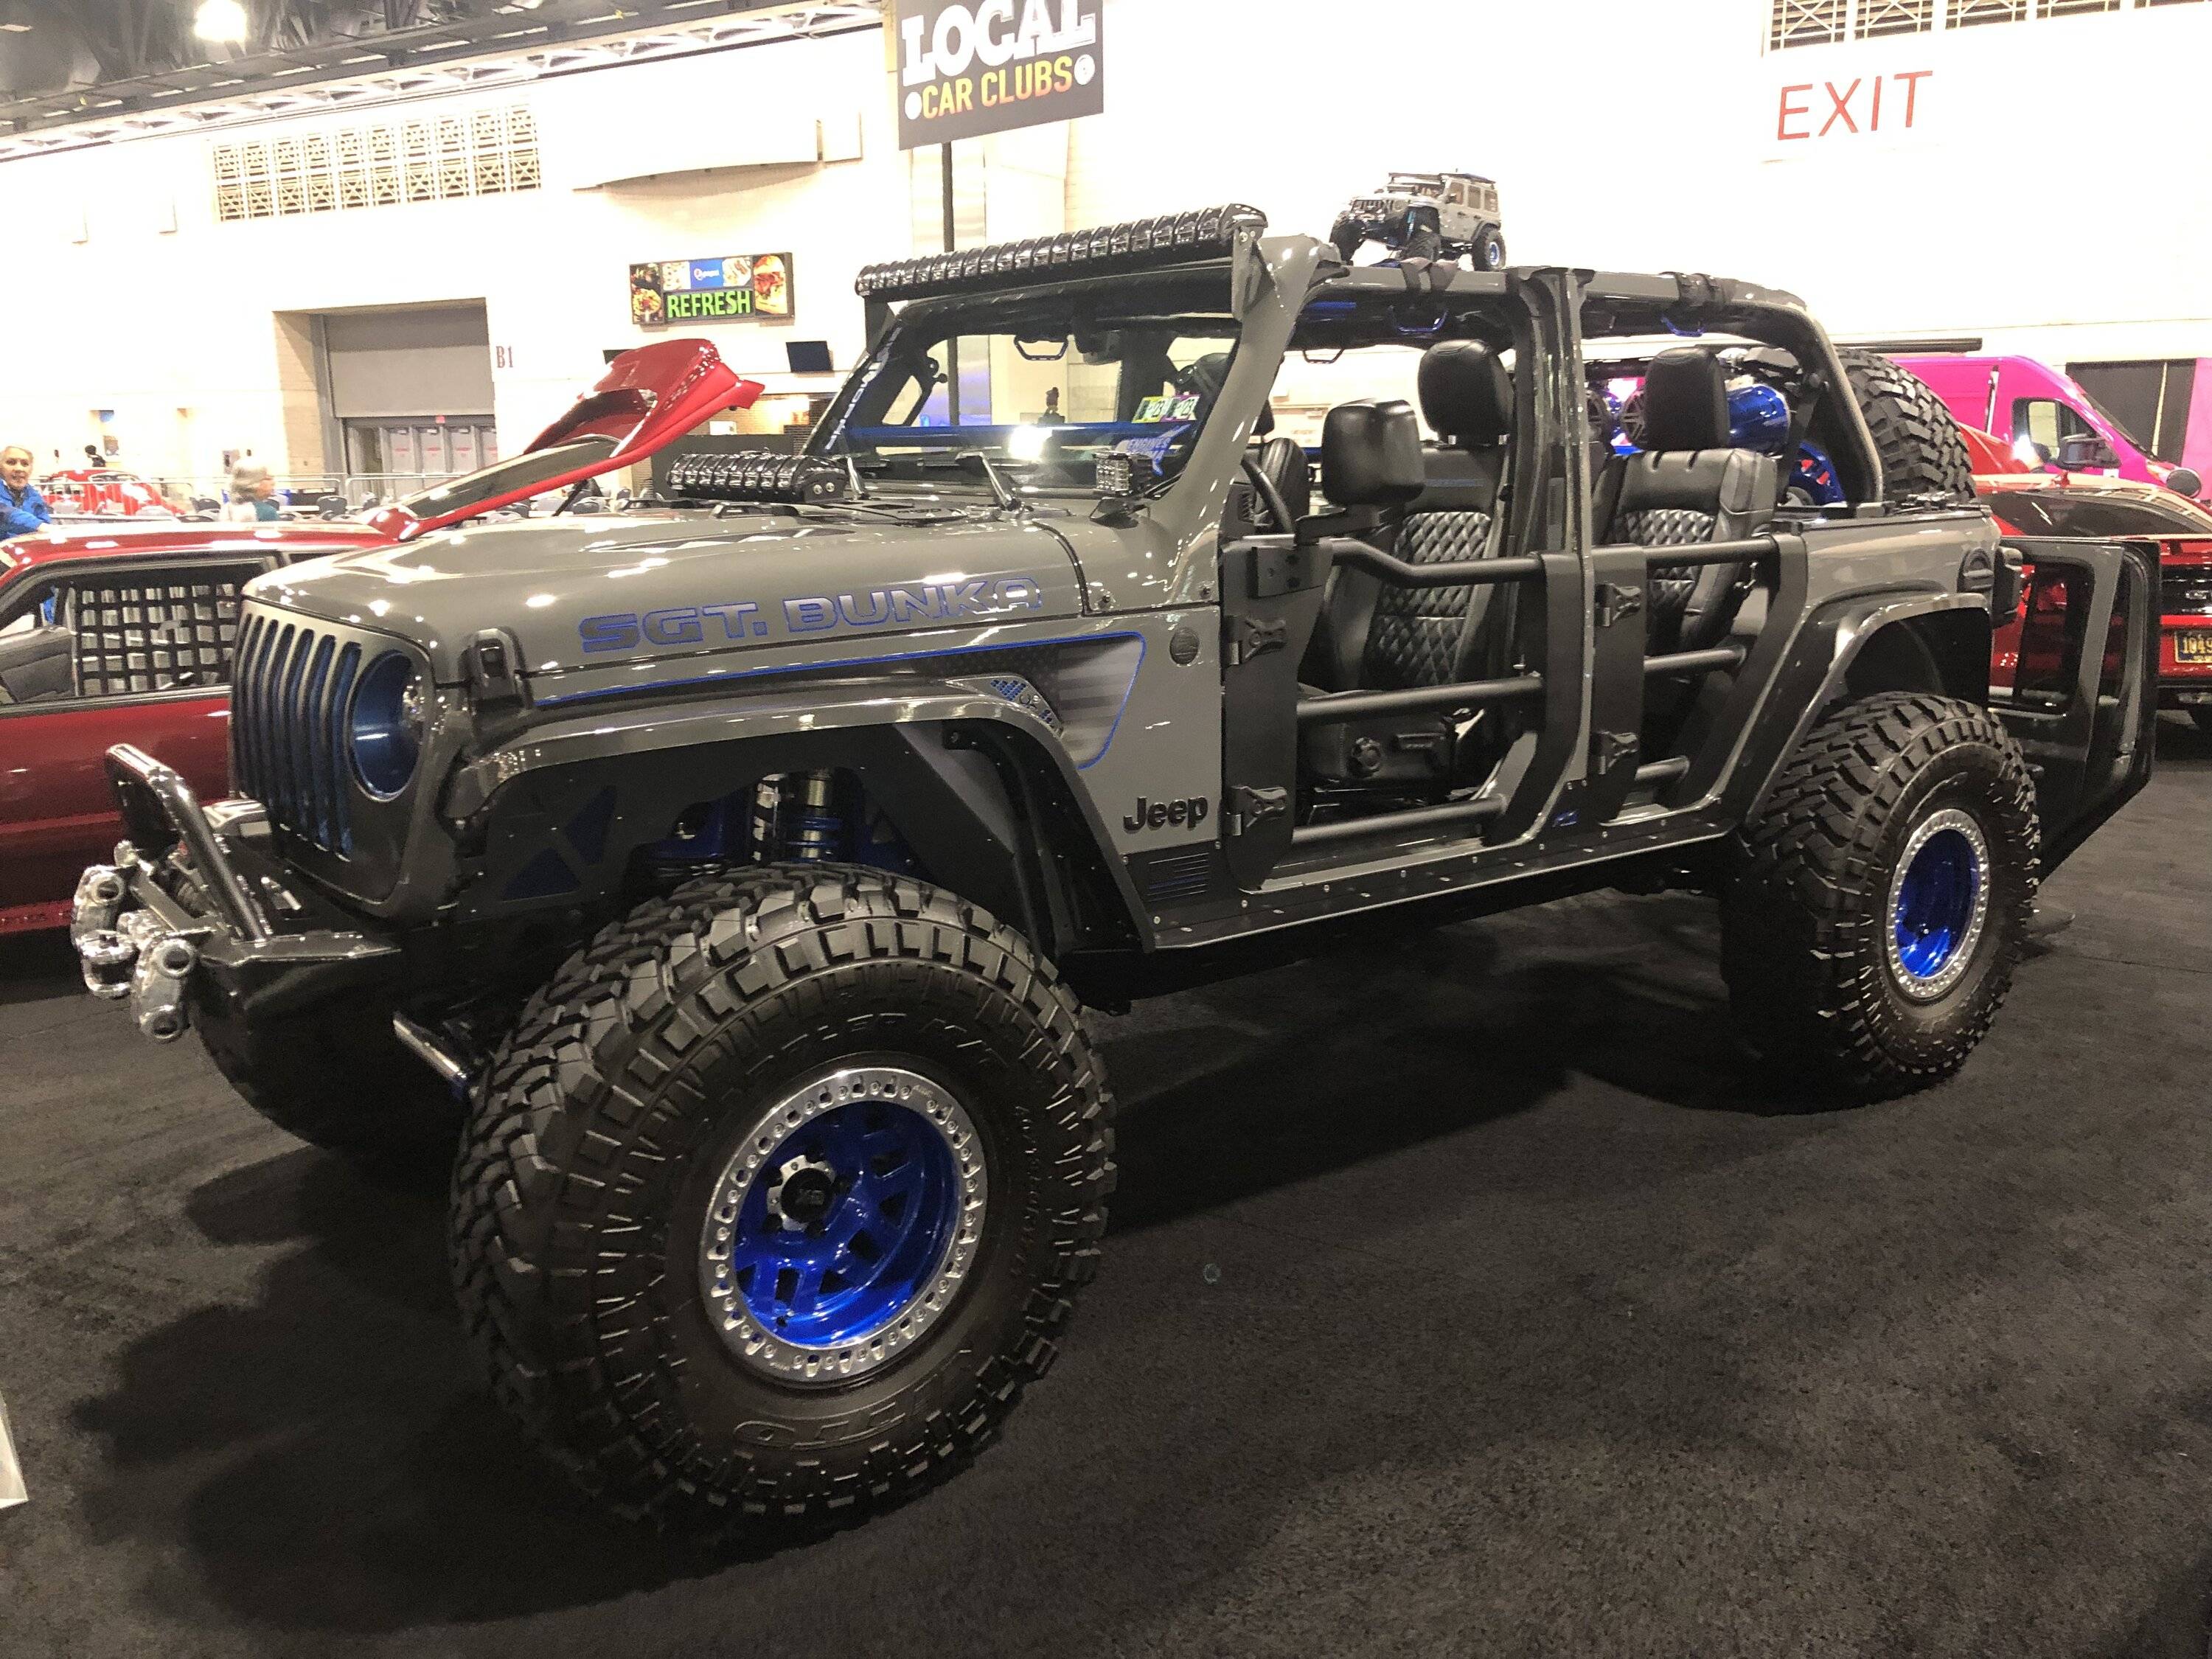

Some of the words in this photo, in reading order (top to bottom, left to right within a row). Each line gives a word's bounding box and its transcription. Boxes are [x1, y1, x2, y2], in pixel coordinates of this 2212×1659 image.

[901, 0, 1096, 86] LOCAL
[922, 77, 974, 119] CAR
[981, 55, 1074, 107] CLUBS
[1778, 70, 1933, 140] EXIT
[667, 291, 751, 318] REFRESH
[495, 346, 514, 369] B1
[577, 602, 768, 653] SGT.
[783, 577, 1042, 633] BUNKA
[1123, 796, 1208, 833] Jeep
